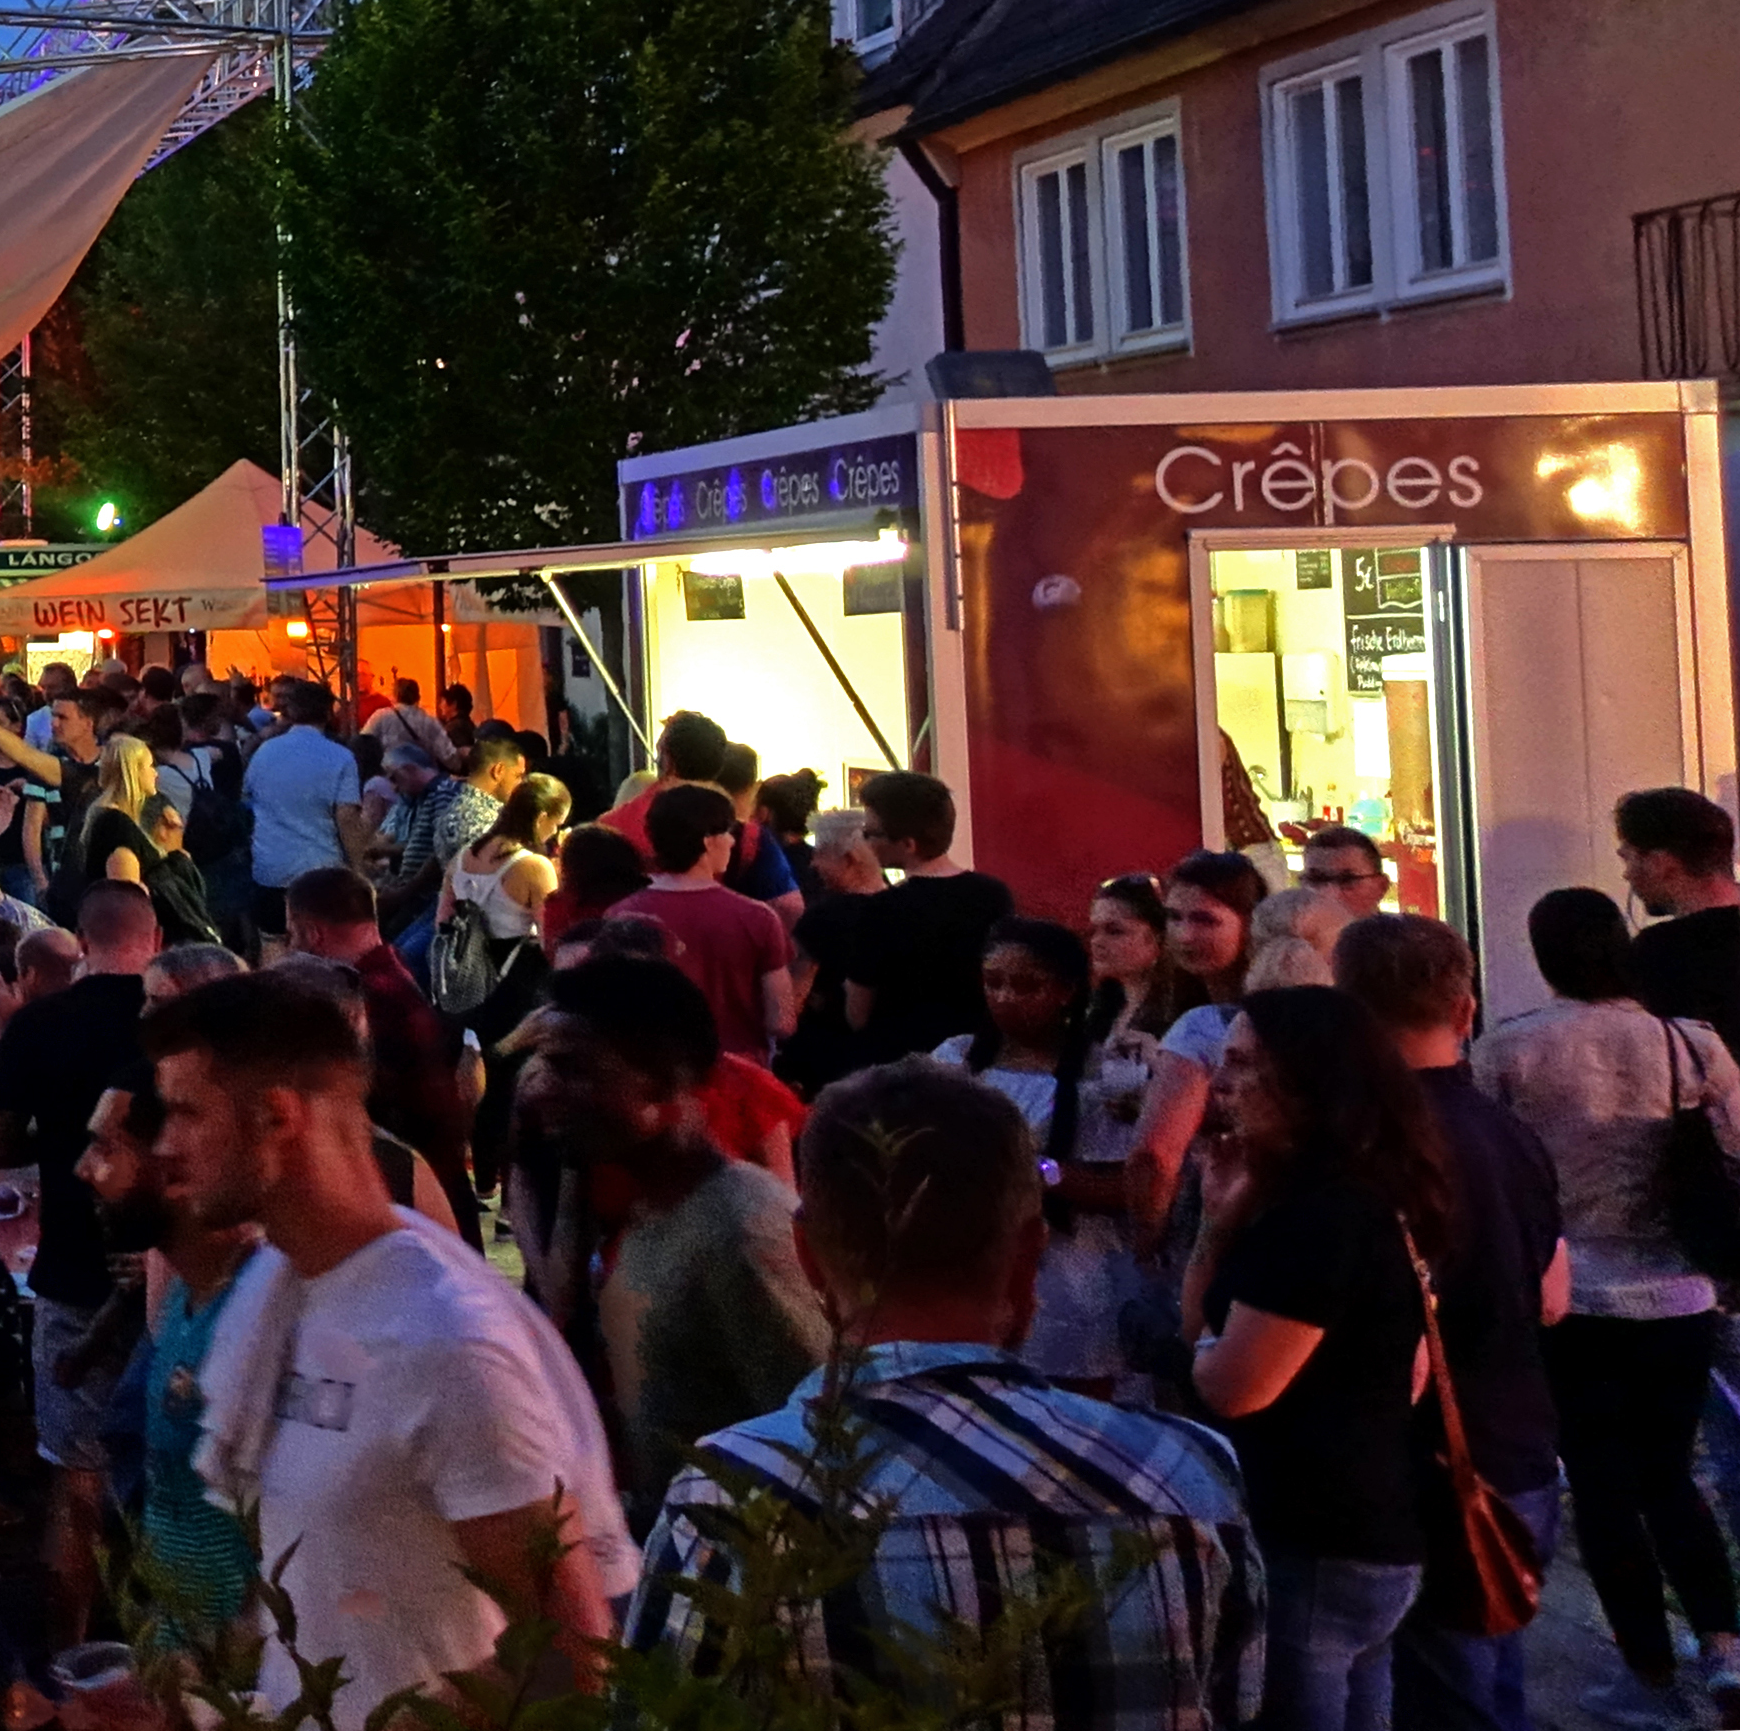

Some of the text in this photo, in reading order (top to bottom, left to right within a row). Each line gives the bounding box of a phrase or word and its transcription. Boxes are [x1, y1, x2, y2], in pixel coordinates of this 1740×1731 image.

[761, 465, 820, 510] Crêpes
[833, 455, 900, 500] Crêpes
[1155, 442, 1484, 526] Crêpes
[8, 550, 99, 567] LÁNGO
[33, 600, 106, 628] WEIN
[119, 596, 193, 628] SEKT
